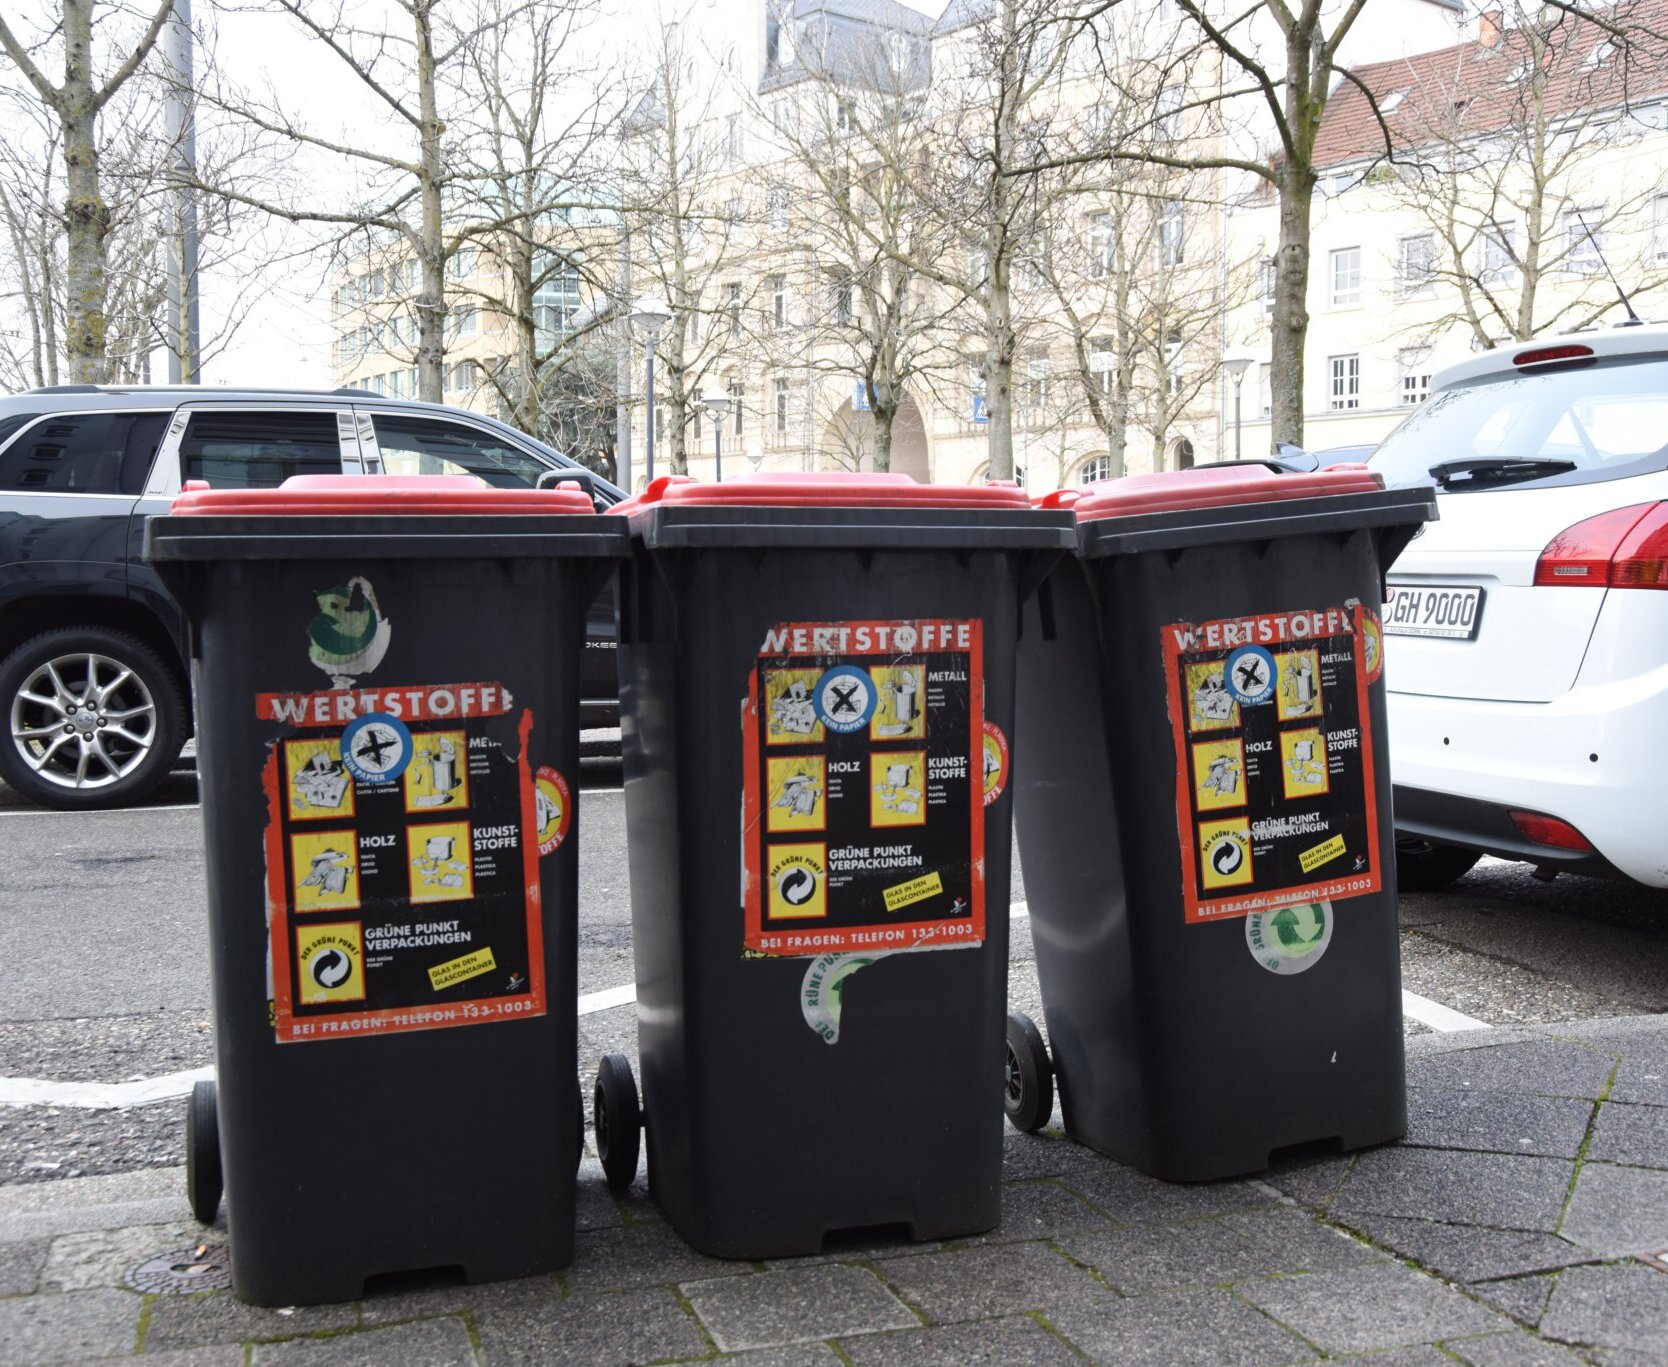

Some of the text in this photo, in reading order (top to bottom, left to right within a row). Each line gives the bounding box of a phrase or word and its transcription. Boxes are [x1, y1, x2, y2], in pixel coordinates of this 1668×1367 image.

[1394, 592, 1475, 626] GH 9000
[1321, 652, 1352, 664] METALL
[928, 671, 967, 682] METALL
[1327, 728, 1359, 741] KUNST-
[1245, 741, 1272, 753] HOLZ
[1328, 739, 1358, 752] STOFFE
[828, 762, 860, 773] HOLZ
[928, 757, 967, 768] KUNST-
[355, 769, 385, 782] PAPIER
[928, 768, 966, 779] STOFFE
[1252, 812, 1320, 832] GRÜNE PUNKT
[473, 825, 518, 838] KUNST-
[1253, 821, 1329, 841] VERPACKUNGEN
[360, 835, 396, 848] HOLZ
[474, 837, 517, 850] STOFFE
[829, 845, 912, 860] GRÜNE PUNKT
[771, 864, 781, 877] DER
[781, 855, 803, 867] GRÜNE
[829, 856, 922, 871] VERPACKUNGEN
[886, 889, 902, 898] GLAS
[913, 880, 926, 889] DEN
[888, 883, 939, 906] GLASCONTAINER
[1199, 906, 1216, 916] BEI
[365, 920, 460, 939] GRÜNE PUNKT
[761, 924, 973, 948] BEI FRAGEN: TELEFON 133-1003
[301, 936, 361, 960] DER GRÜNE PUNKT
[365, 931, 471, 951] VERPACKUNGEN
[432, 966, 451, 977] GLAS
[463, 956, 477, 966] DEN
[434, 960, 493, 985] GLASCONTAINER
[293, 1000, 532, 1036] BEI FRAGEN: TELEFON 133-1003
